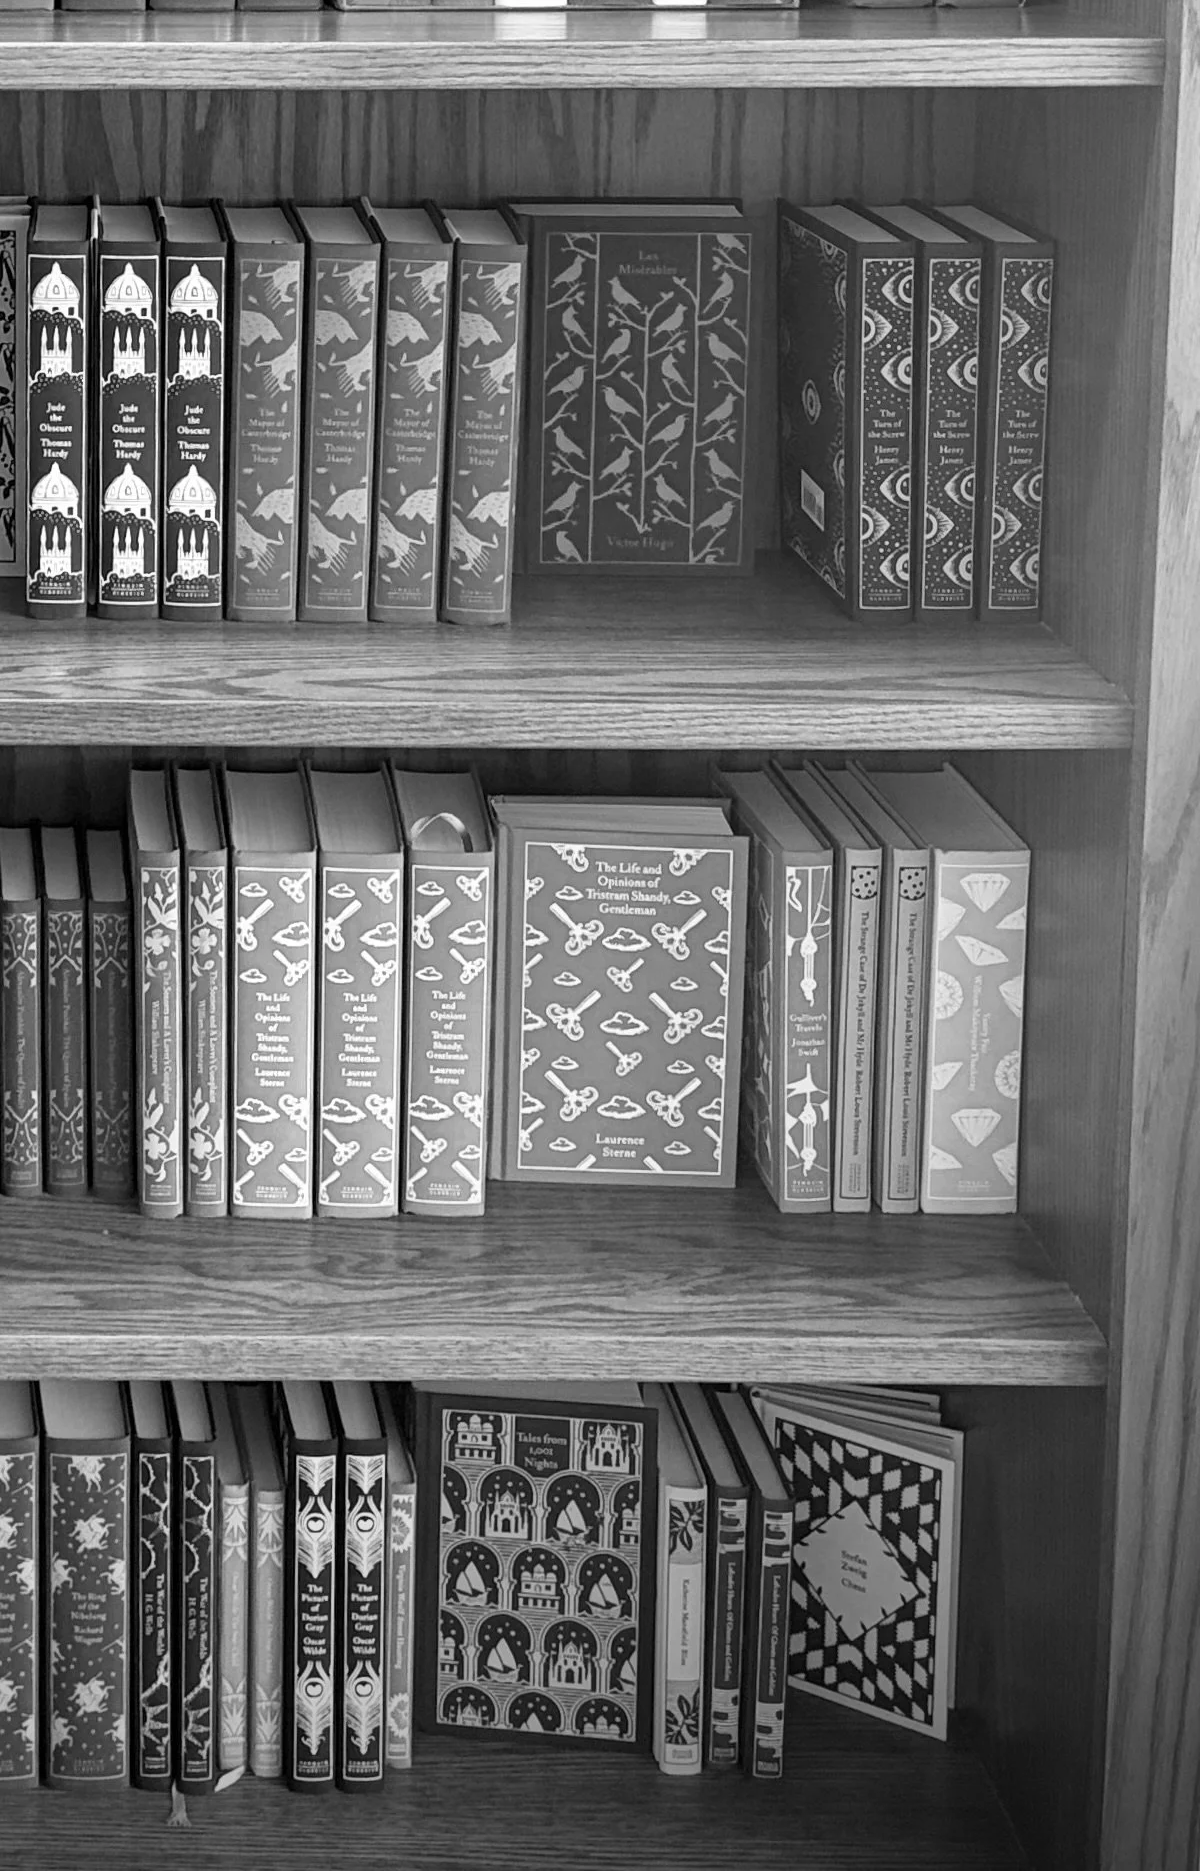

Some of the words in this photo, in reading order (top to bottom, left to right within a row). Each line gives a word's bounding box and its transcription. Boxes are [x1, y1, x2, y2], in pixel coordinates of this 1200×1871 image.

[46, 402, 66, 414] Jude
[50, 413, 62, 422] the
[39, 423, 73, 432] Obscure
[40, 438, 72, 447] Thomas
[43, 448, 68, 460] Hardy
[595, 861, 617, 874] The
[620, 862, 642, 874] Life
[644, 863, 662, 875] and
[598, 875, 646, 889] Opinions
[647, 877, 661, 889] of
[586, 888, 630, 900] Tristram
[631, 889, 671, 905] Shandy,
[599, 902, 657, 916] Gentleman
[255, 992, 272, 1002] The
[273, 992, 291, 1002] Life
[266, 1003, 281, 1012] and
[255, 1012, 291, 1024] Opinions
[268, 1023, 279, 1032] of
[256, 1032, 290, 1042] Tristram
[251, 1052, 294, 1063] Gentleman
[255, 1067, 291, 1077] Laurence
[260, 1078, 285, 1087] Sterne
[595, 1132, 645, 1146] Laurence
[602, 1147, 637, 1159] Sterne
[517, 1431, 542, 1443] Tales
[543, 1433, 568, 1446] from
[524, 1456, 558, 1471] Nights
[841, 1549, 868, 1566] Stefan
[841, 1560, 868, 1580] Zweig
[307, 1584, 323, 1593] The
[841, 1577, 866, 1593] Chess
[301, 1593, 329, 1602] Picture
[310, 1604, 320, 1613] of
[301, 1612, 329, 1622] Dorian
[305, 1622, 324, 1633] Gray
[303, 1636, 326, 1646] Oscar
[303, 1646, 327, 1655] Wilde
